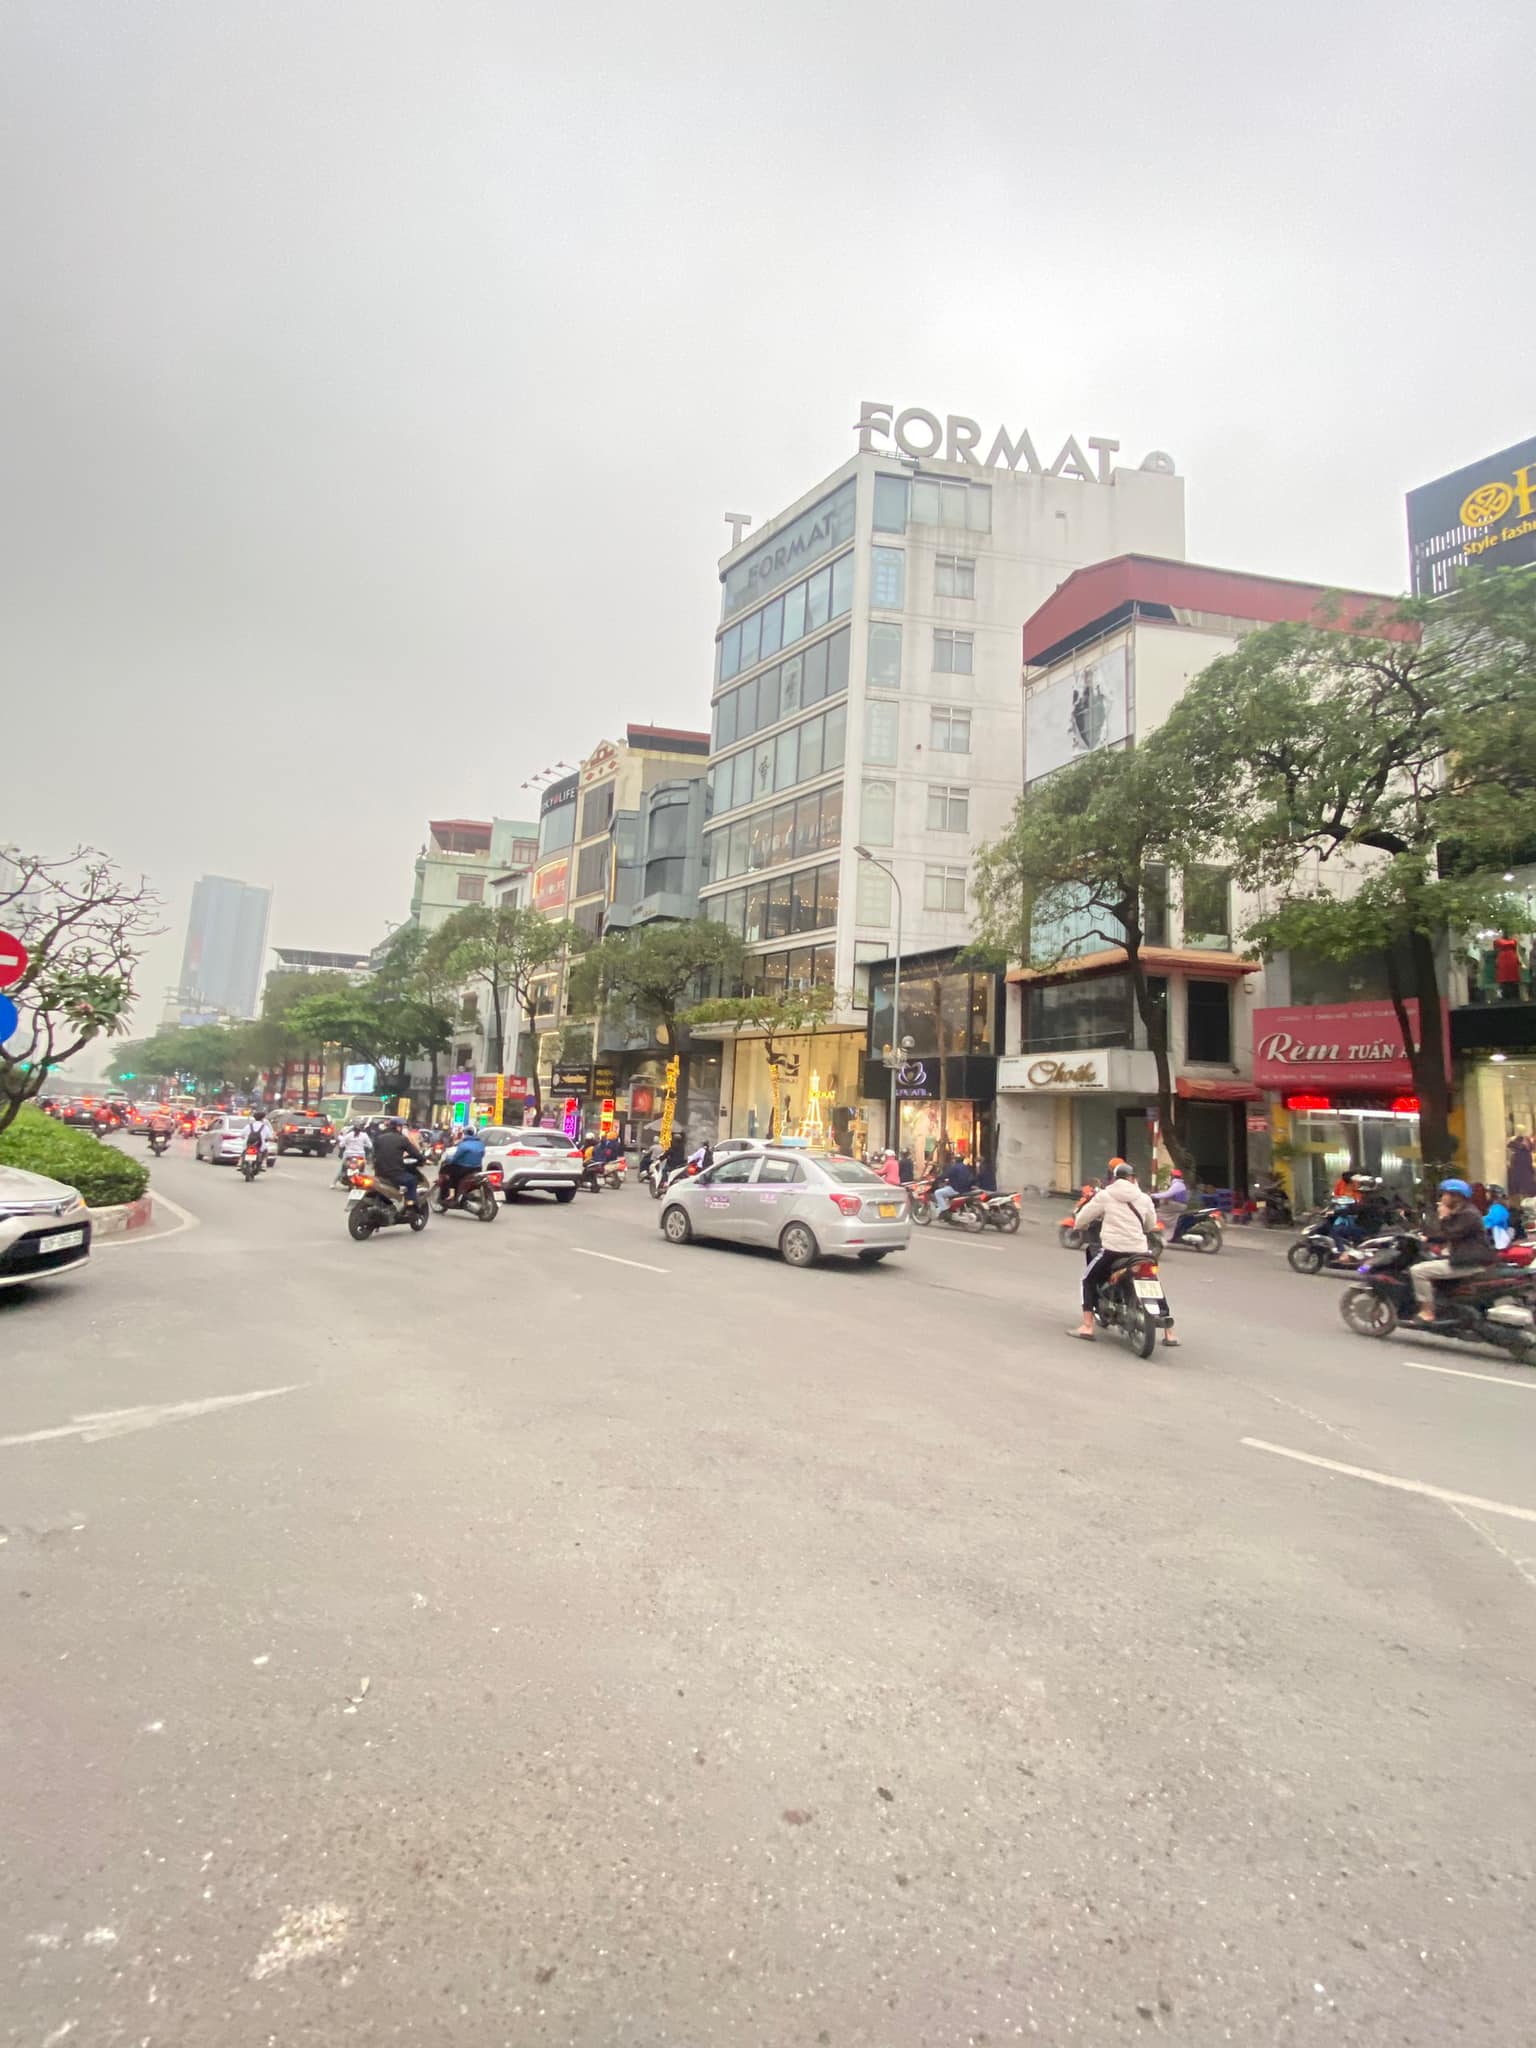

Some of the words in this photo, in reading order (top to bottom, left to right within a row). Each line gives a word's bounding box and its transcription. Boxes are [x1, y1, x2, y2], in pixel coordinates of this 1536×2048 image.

[853, 400, 1121, 486] FORMAT
[748, 510, 836, 588] FORMAT
[1463, 535, 1498, 556] Style
[1257, 1032, 1340, 1064] Rèm
[1347, 1038, 1397, 1061] TUẤN
